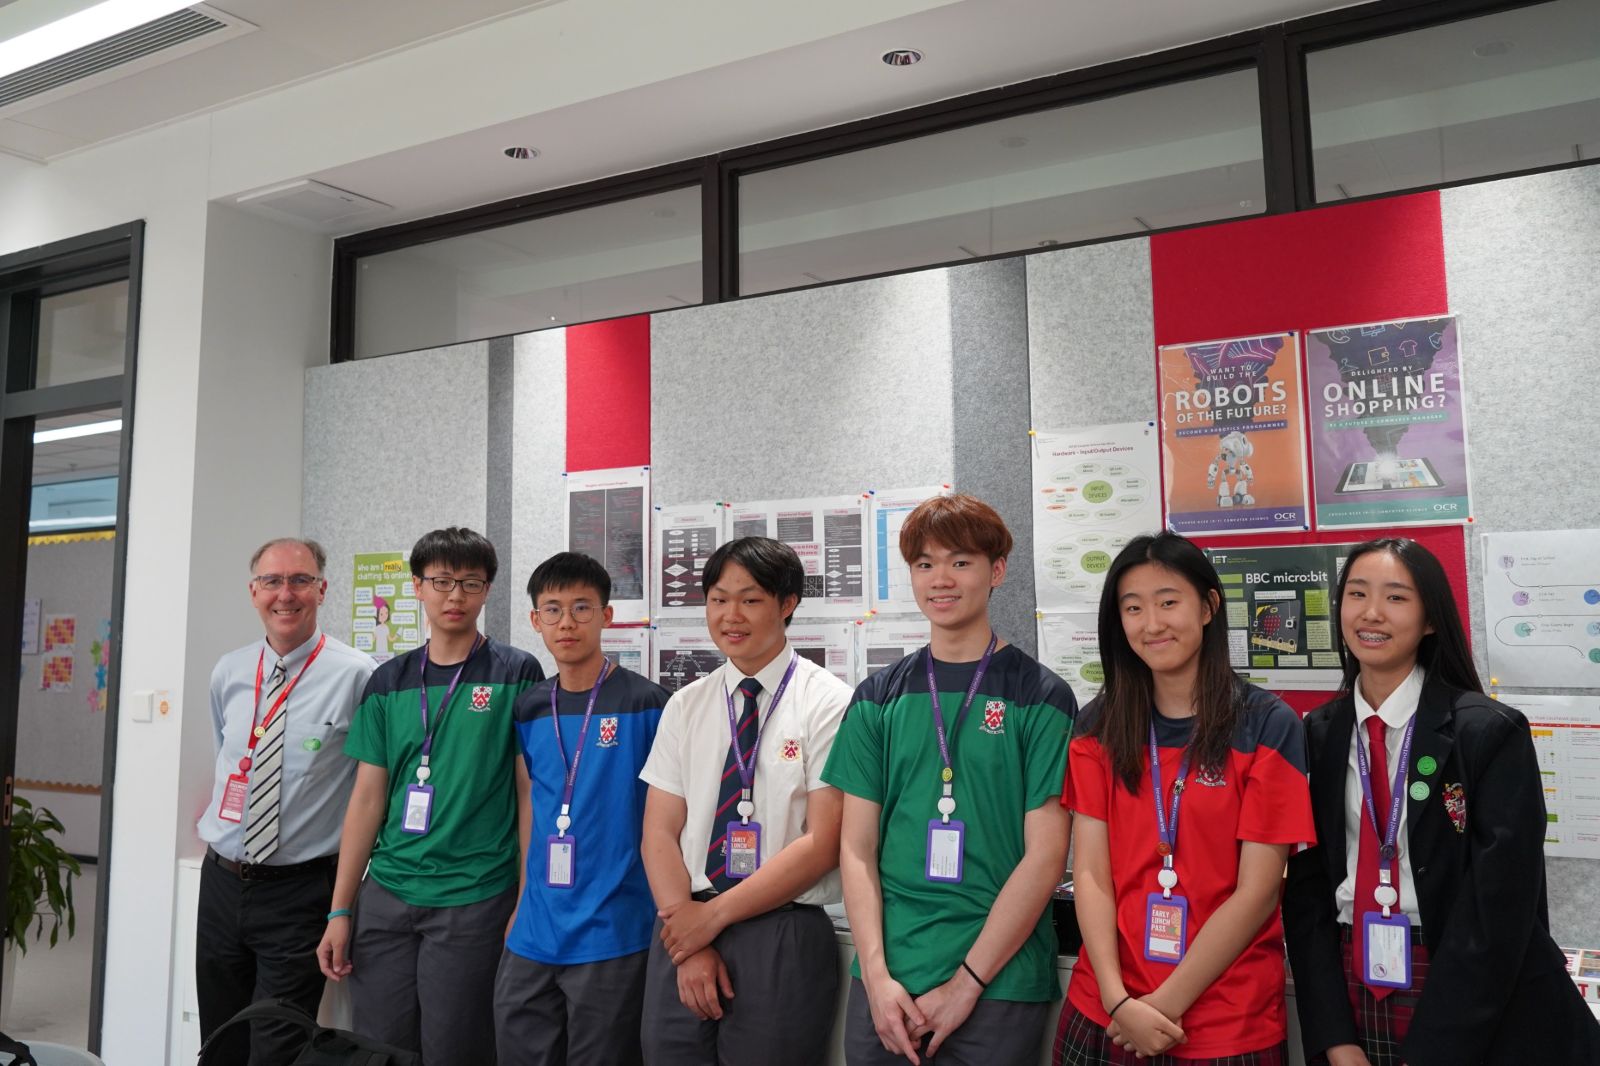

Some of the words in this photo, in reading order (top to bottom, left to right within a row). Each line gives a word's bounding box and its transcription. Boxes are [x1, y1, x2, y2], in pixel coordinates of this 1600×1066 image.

[1210, 366, 1236, 375] WANT
[1351, 368, 1398, 376] DELIGHTED
[1206, 373, 1234, 382] BUILD
[1323, 373, 1445, 402] ONLINE
[1176, 380, 1286, 410] ROBOTS
[1325, 395, 1446, 417] SHOPPING?
[1177, 412, 1194, 424] OF
[1197, 410, 1223, 421] THE
[1227, 404, 1286, 419] FUTURE?
[1433, 503, 1457, 511] OCR
[385, 563, 402, 572] really
[1246, 573, 1270, 584] BBC
[1274, 571, 1328, 583] micro:bit
[1152, 909, 1169, 918] EARLY
[1152, 917, 1170, 926] LUNCH
[1151, 924, 1166, 932] PASS
